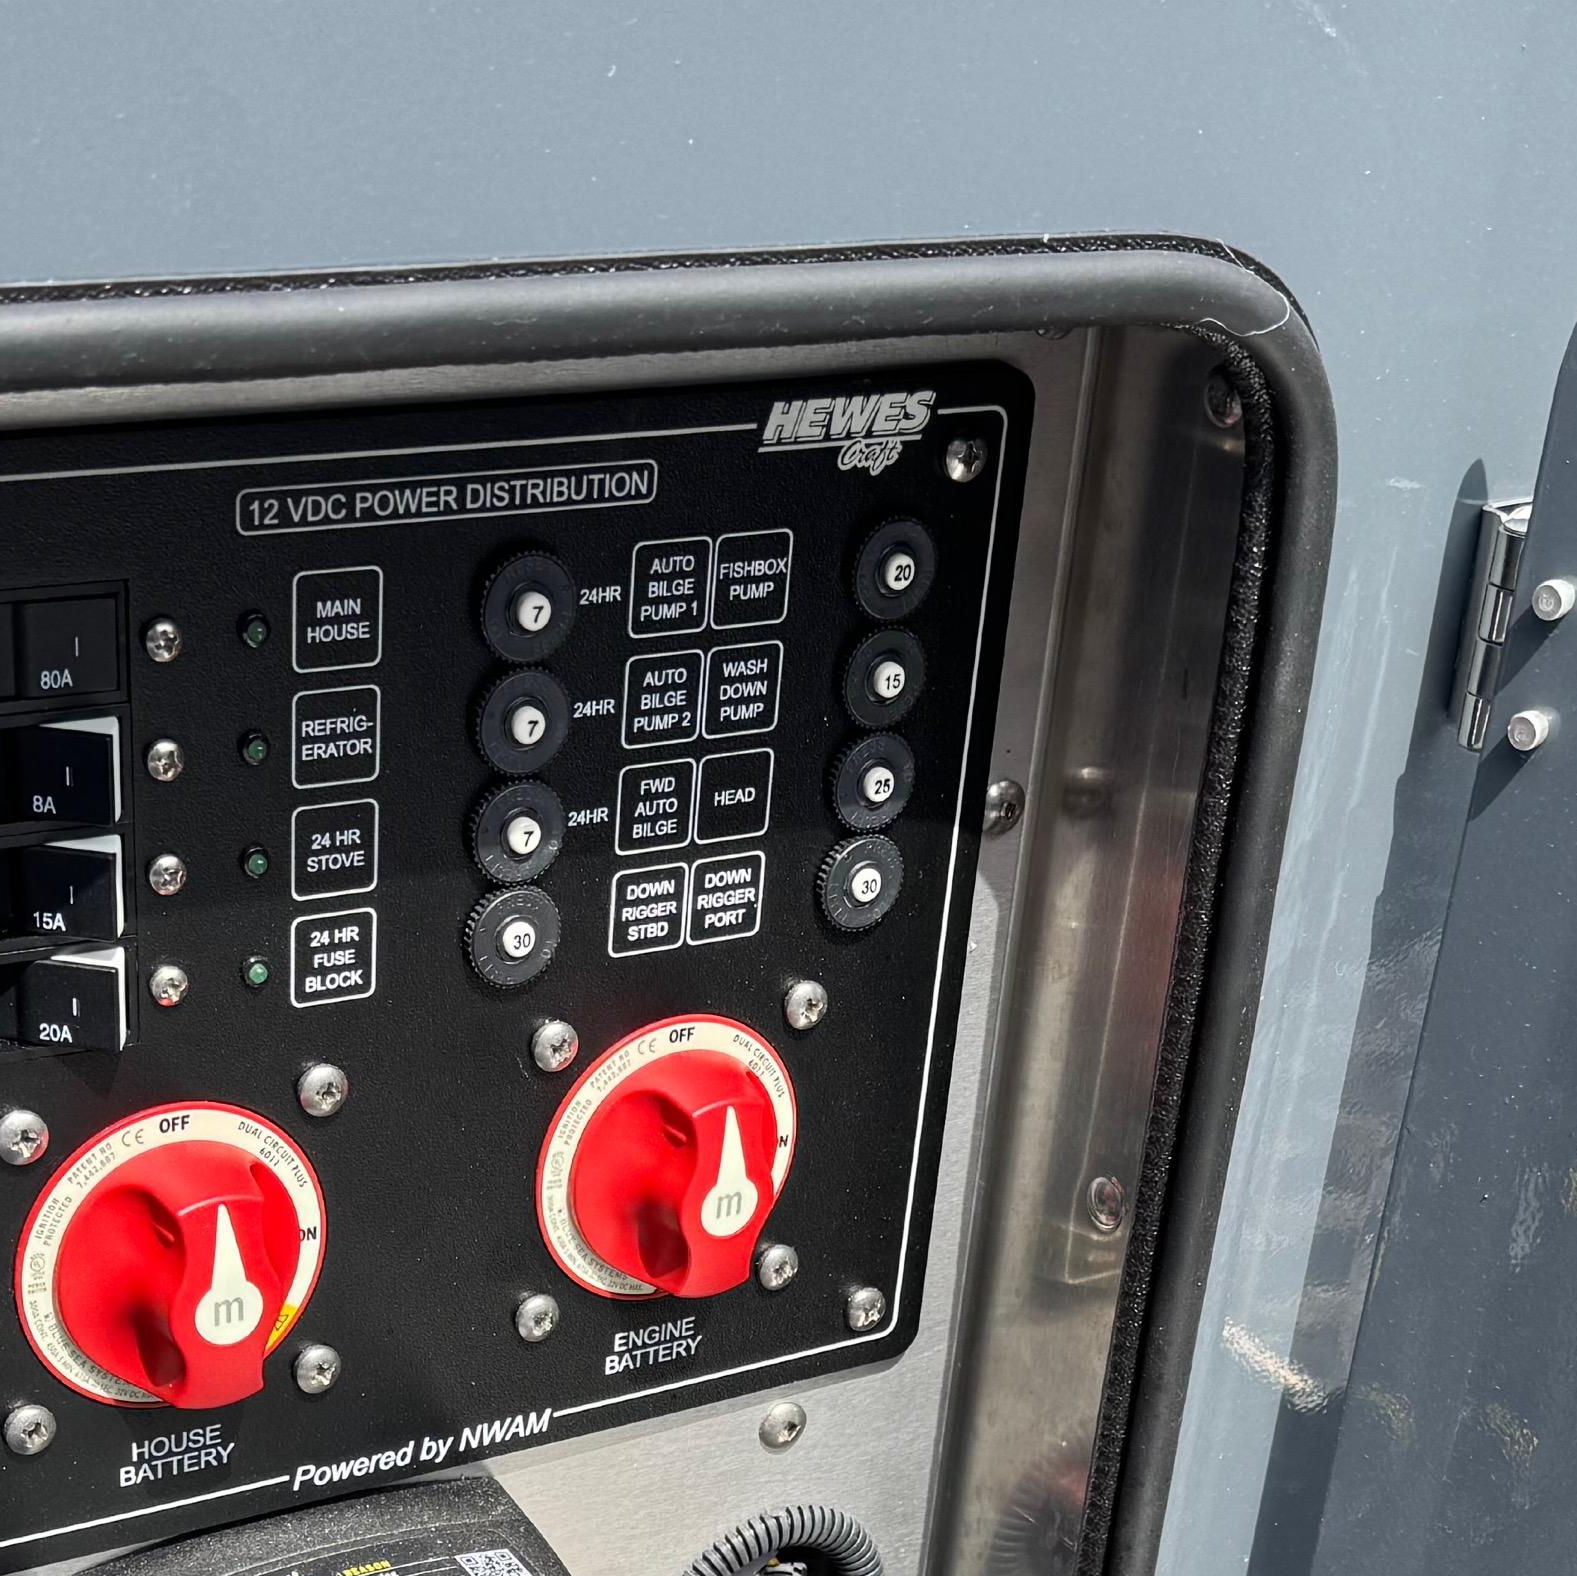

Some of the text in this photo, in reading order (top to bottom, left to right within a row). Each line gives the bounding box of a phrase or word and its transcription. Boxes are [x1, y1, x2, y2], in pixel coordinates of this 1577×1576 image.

[763, 390, 936, 443] HEWES
[249, 471, 649, 526] 12 VDC POWER DISTRIBUTION
[650, 555, 695, 575] AUTO
[719, 557, 788, 579] FISHBOX
[894, 564, 912, 582] 20
[579, 586, 622, 605] 24HR
[648, 579, 695, 598] BILGE
[729, 582, 775, 601] PUMP
[317, 599, 361, 618] MAIN
[531, 605, 544, 623] 7
[640, 600, 699, 622] PUMP 1
[307, 622, 370, 643] HOUSE
[642, 668, 687, 687] AUTO
[722, 658, 768, 678] WASH
[40, 669, 73, 689] 80A
[884, 674, 902, 691] 15
[640, 690, 687, 710] BILGE
[719, 681, 767, 701] DOWN
[573, 699, 615, 718] 24HR
[720, 702, 764, 722] PUMP
[302, 715, 374, 737] REFRIG-
[527, 720, 539, 737] 7
[633, 712, 691, 733] PUMP 2
[302, 738, 372, 760] ERATOR
[640, 777, 675, 796] FWD
[714, 787, 756, 806] HEAD
[874, 779, 891, 795] 25
[32, 795, 56, 814] 8A
[634, 799, 678, 818] AUTO
[568, 807, 609, 827] 24HR
[523, 831, 534, 847] 7
[632, 819, 678, 839] BILGE
[311, 829, 361, 850] 24 HR
[307, 851, 365, 872] STOVE
[704, 868, 752, 888] DOWN
[861, 879, 877, 894] 30
[626, 880, 675, 901] DOWN
[697, 888, 756, 910] RIGGER
[33, 912, 66, 931] 15A
[622, 901, 677, 922] RIGGER
[704, 909, 746, 929] PORT
[310, 926, 360, 947] 24 HR
[627, 921, 669, 941] STBD
[513, 934, 531, 950] 30
[313, 950, 355, 968] FUSE
[305, 970, 363, 993] BLOCK
[39, 1023, 73, 1043] 20A
[669, 1027, 695, 1043] OFF
[733, 1034, 752, 1052] DUAL
[753, 1048, 776, 1078] CIRCUIT
[159, 1115, 190, 1134] OFF
[238, 1121, 308, 1188] DUAL CIRCUIT PLUS
[34, 1197, 59, 1239] IGNITION
[43, 1196, 72, 1246] PROTECTED
[614, 1316, 696, 1352] ENGINE
[68, 1348, 88, 1368] SEA
[604, 1335, 703, 1375] BATTERY
[131, 1424, 222, 1462] HOUSE
[293, 1408, 552, 1491] Powered by NWAM
[119, 1442, 235, 1487] BATTERY
